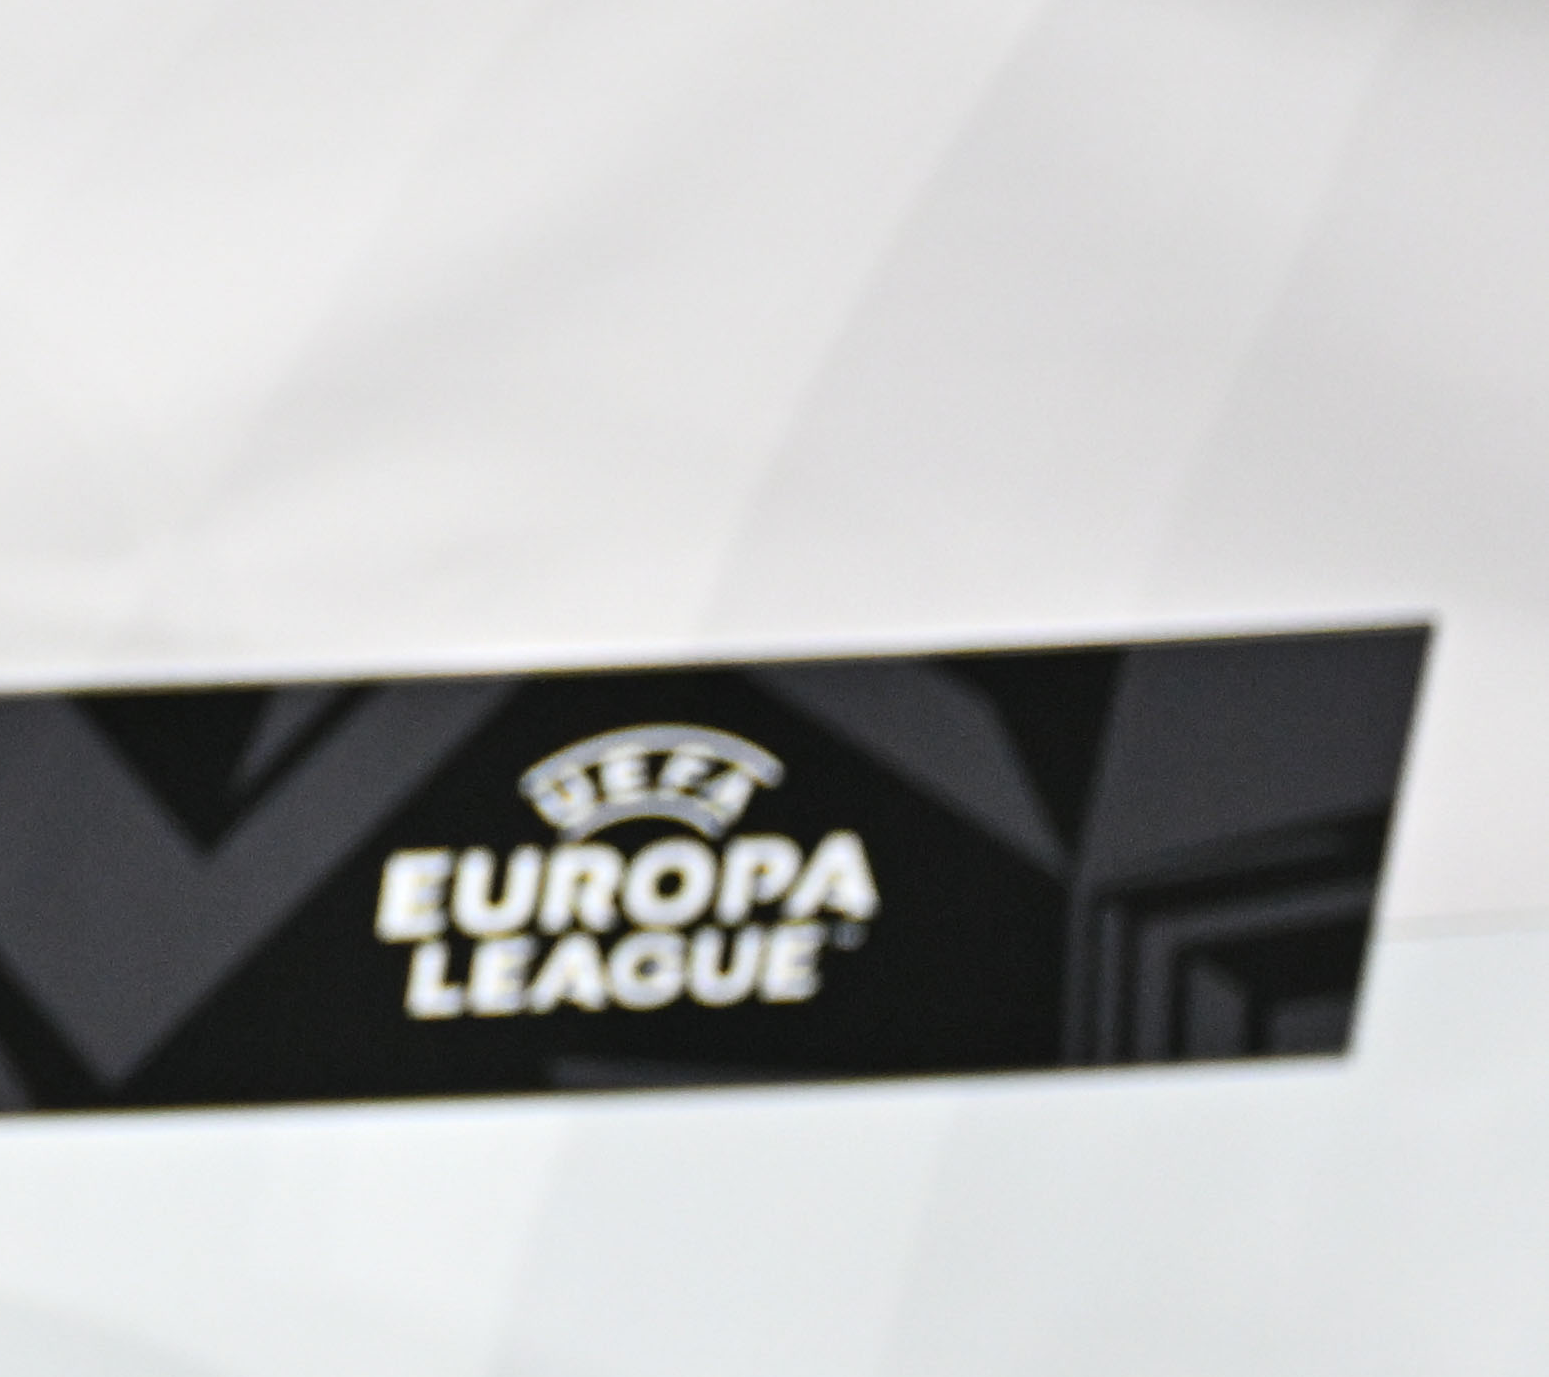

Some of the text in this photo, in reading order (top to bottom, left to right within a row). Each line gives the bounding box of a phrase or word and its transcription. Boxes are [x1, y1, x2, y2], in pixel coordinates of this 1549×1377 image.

[529, 733, 769, 831] UEFA
[375, 830, 879, 941] EUROPA
[404, 925, 825, 1019] LEAGUE
